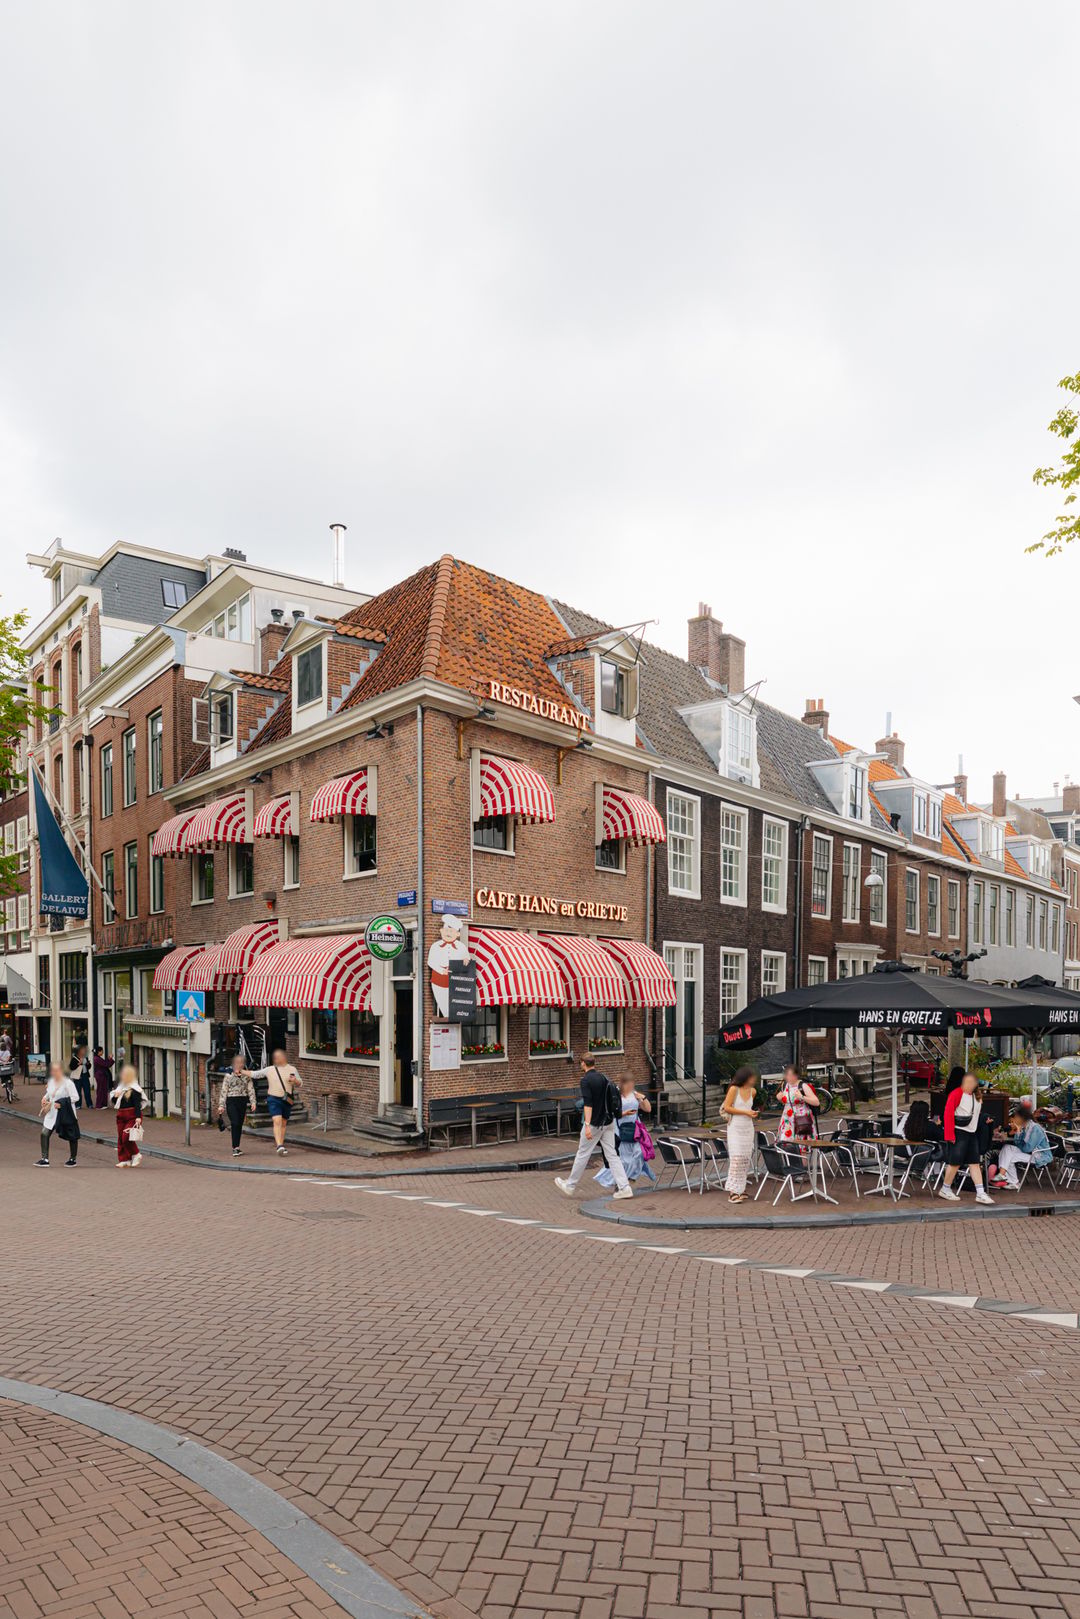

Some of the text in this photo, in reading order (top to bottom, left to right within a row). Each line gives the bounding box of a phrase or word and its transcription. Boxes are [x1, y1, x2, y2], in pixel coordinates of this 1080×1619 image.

[490, 681, 589, 731] RESTAURANT
[41, 893, 87, 904] GALLERY
[477, 889, 628, 922] CAFE HANS en GRIETJE
[41, 903, 86, 915] DELAIVE
[371, 933, 403, 942] Heineken
[858, 1010, 943, 1025] HANS EN GRIETJE
[956, 1011, 981, 1026] Duvel
[1049, 1010, 1079, 1023] HANS EN
[723, 1028, 743, 1043] Duvel
